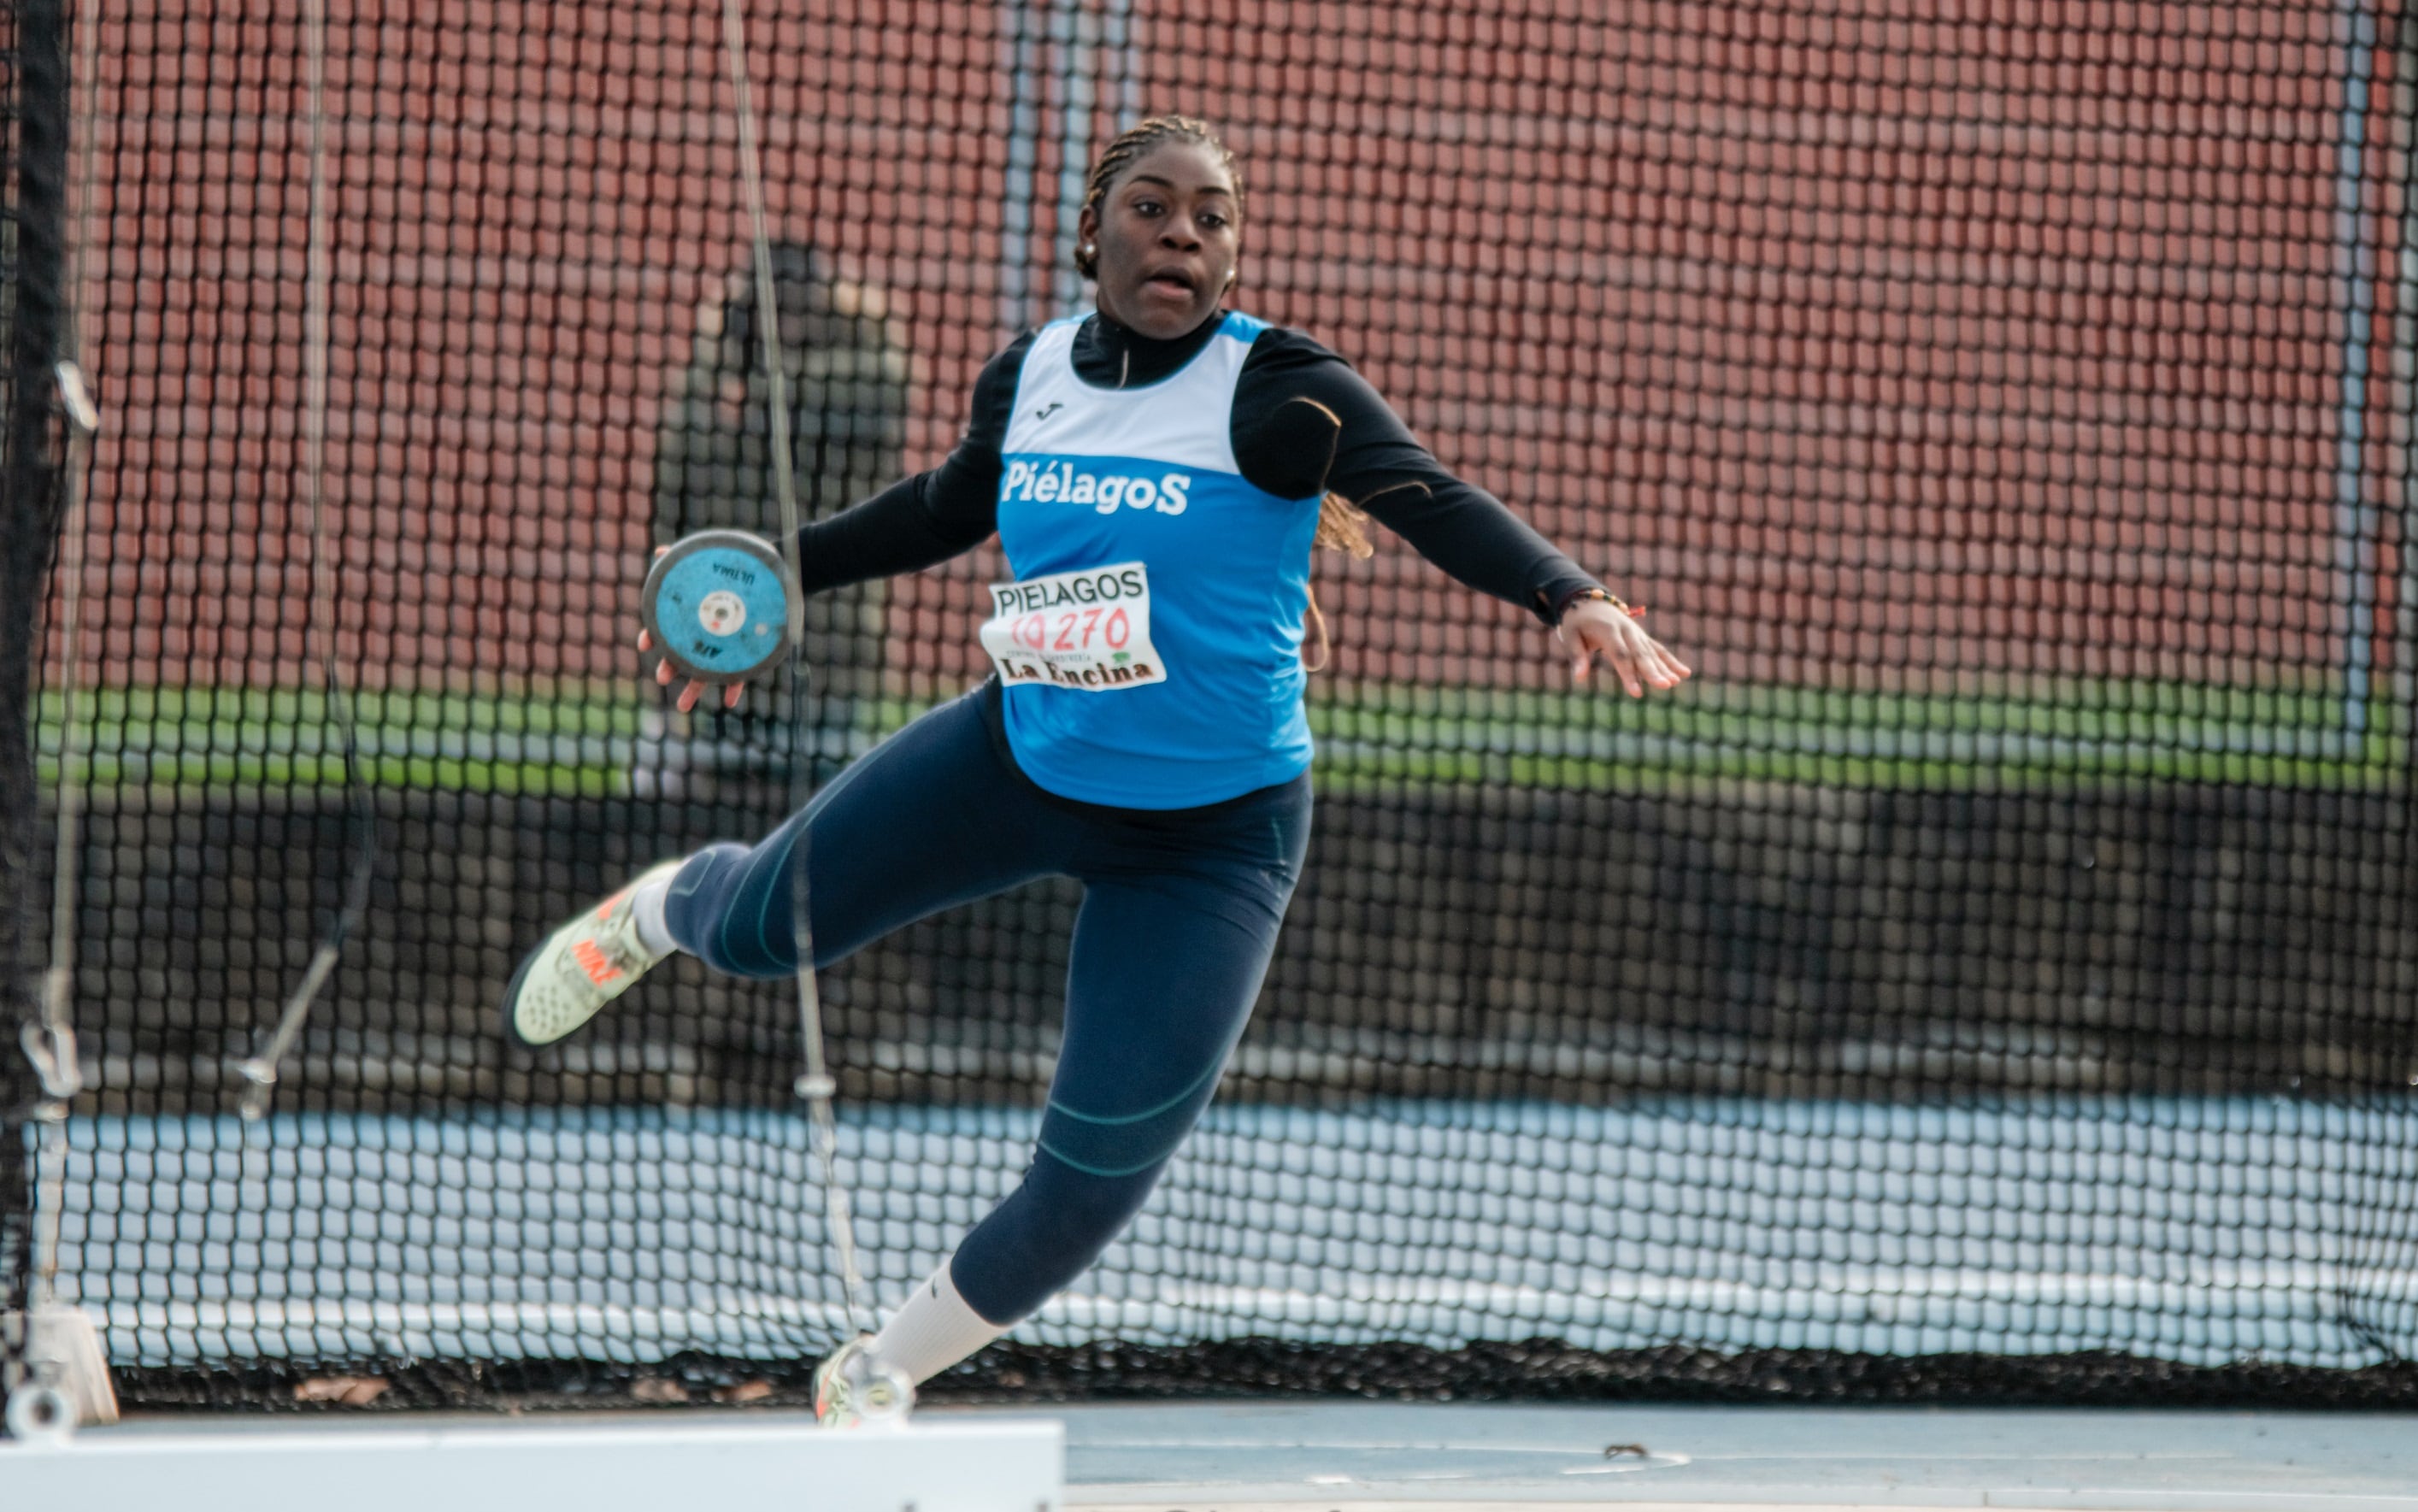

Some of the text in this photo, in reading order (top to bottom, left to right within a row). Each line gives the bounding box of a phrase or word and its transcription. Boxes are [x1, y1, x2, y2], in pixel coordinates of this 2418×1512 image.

[997, 570, 1144, 616] PIELAGOS
[999, 658, 1040, 680] La
[1044, 662, 1154, 686] Encina
[572, 937, 623, 988] NIKE
